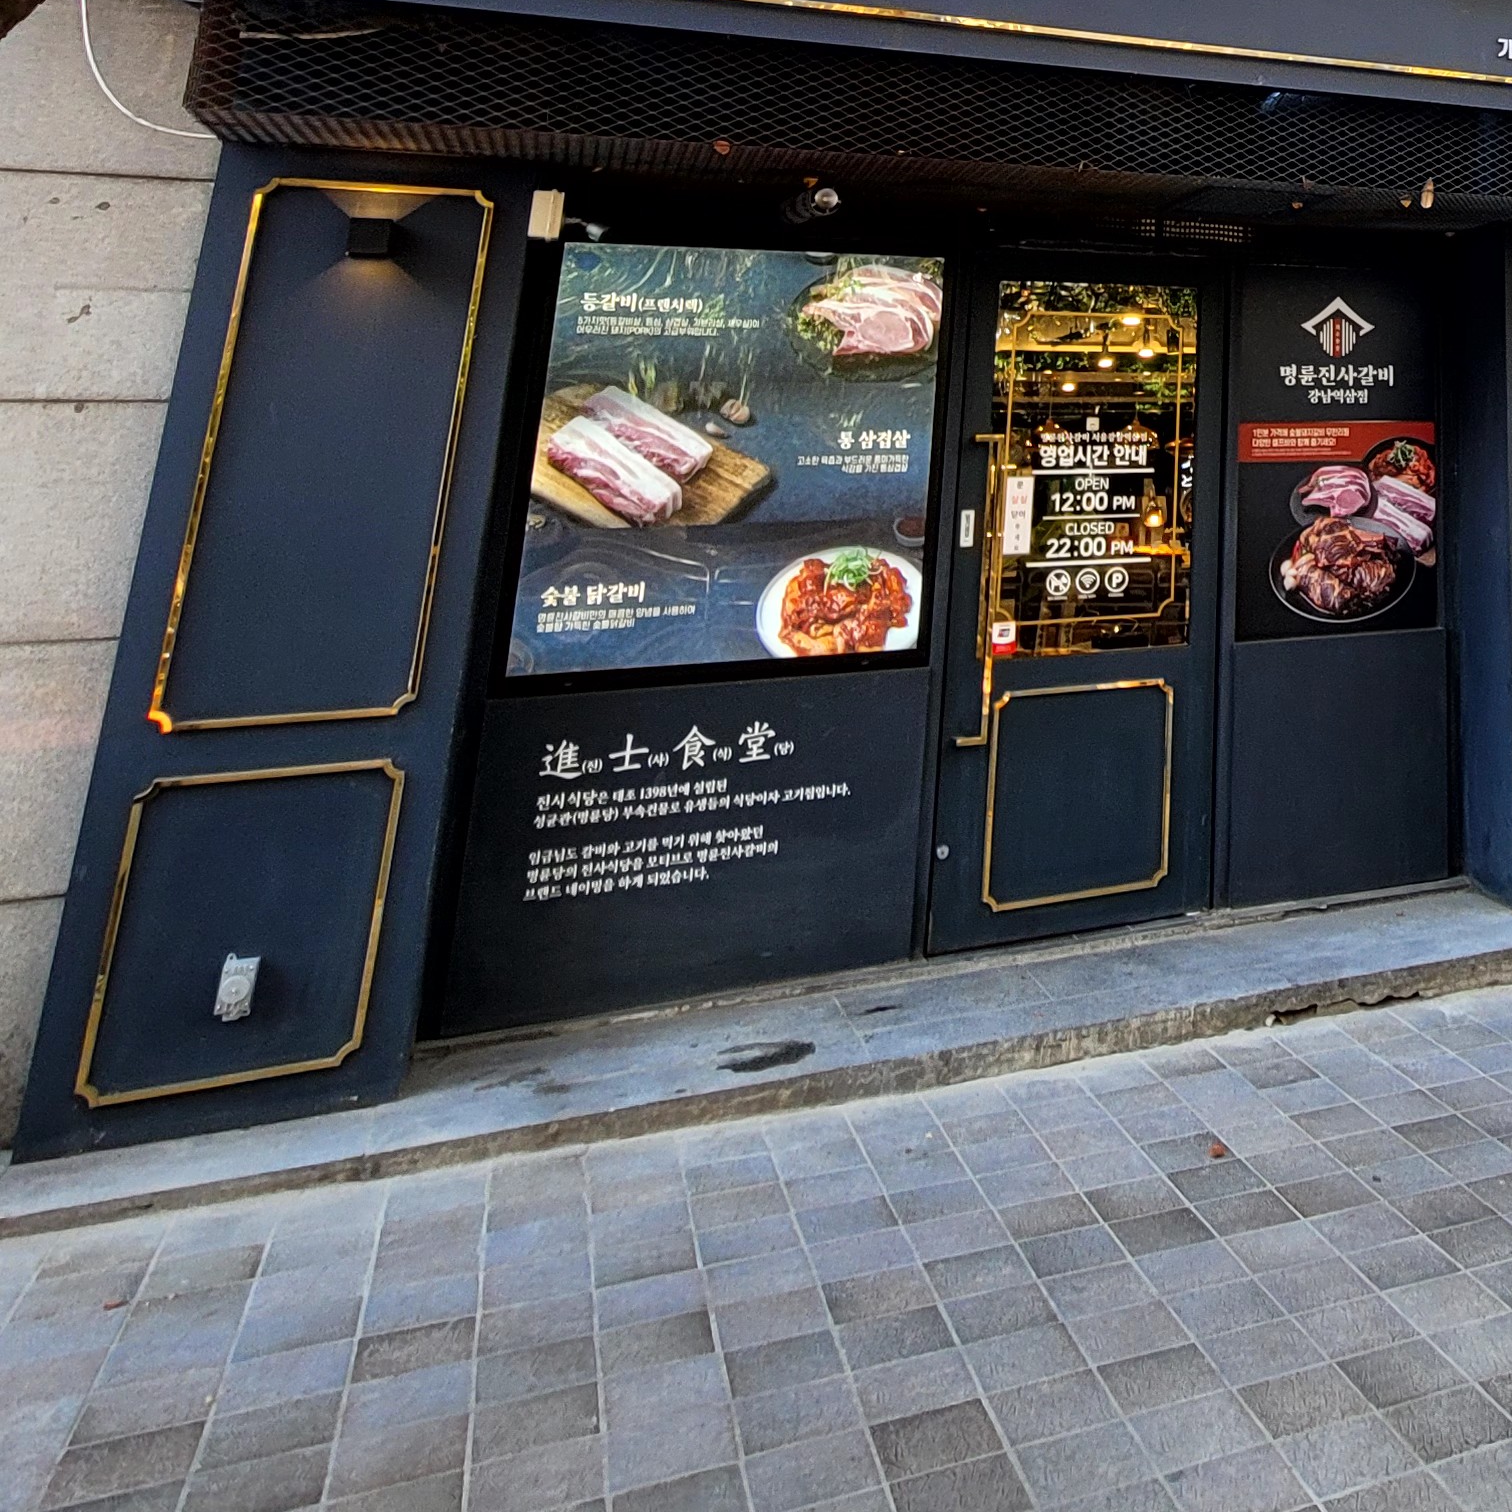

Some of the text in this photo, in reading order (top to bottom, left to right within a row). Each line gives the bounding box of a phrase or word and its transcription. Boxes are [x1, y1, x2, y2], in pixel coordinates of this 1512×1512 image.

[1279, 364, 1394, 387] 명륜진사갈비
[1307, 389, 1369, 404] 강남역삼점
[858, 429, 911, 450] 삼겹살
[1040, 444, 1148, 467] 영업시간 안내
[1074, 477, 1110, 491] OPEN
[1051, 491, 1135, 512] 12:00 PM
[1065, 522, 1114, 536] CLOSED
[1046, 537, 1134, 559] 22:00 PM
[586, 581, 645, 605] 닭갈비
